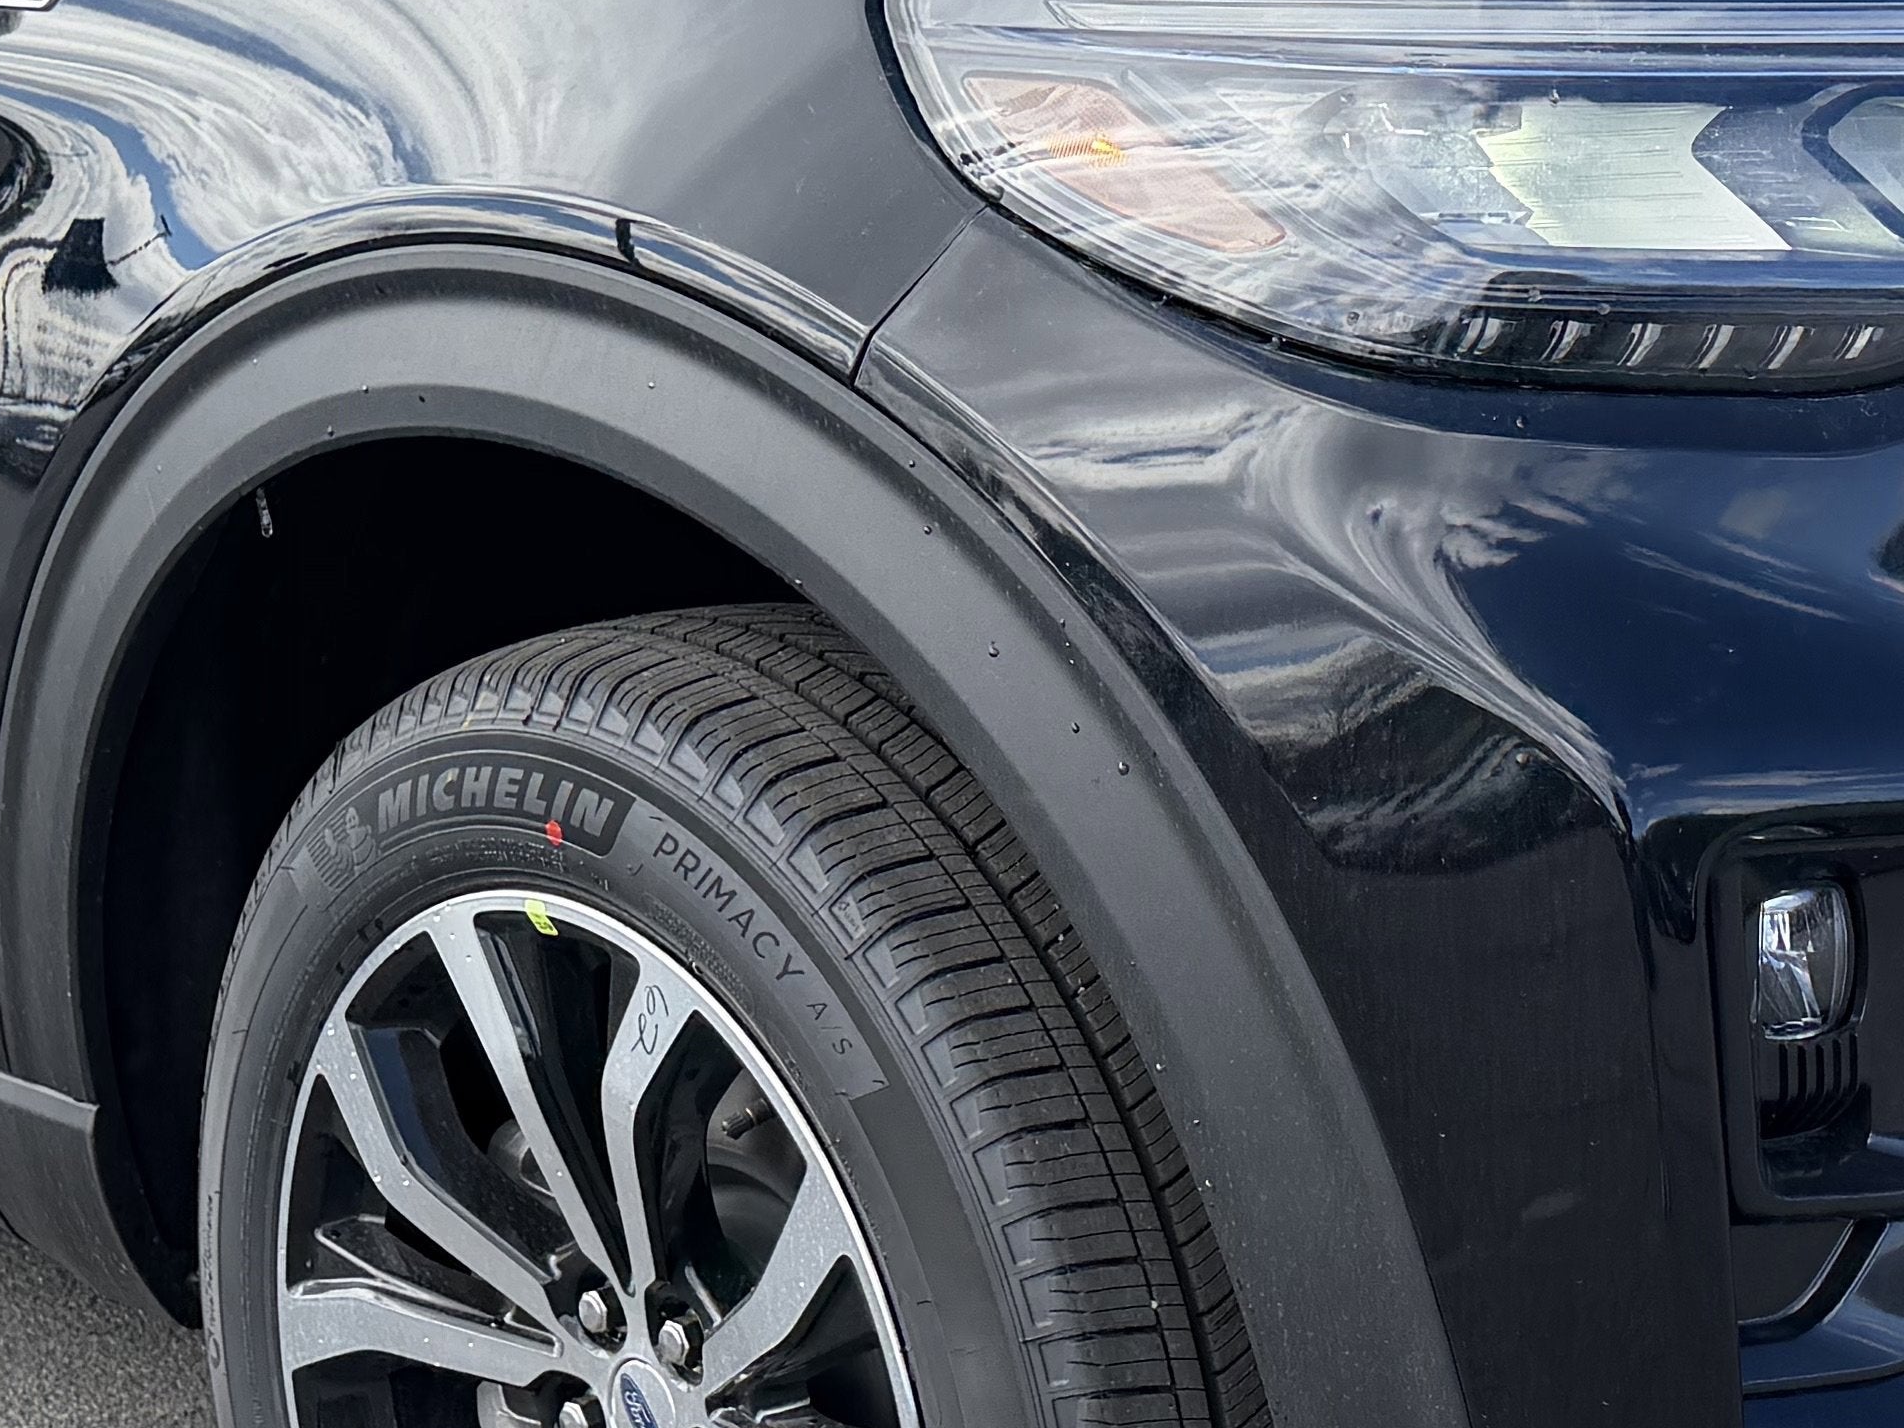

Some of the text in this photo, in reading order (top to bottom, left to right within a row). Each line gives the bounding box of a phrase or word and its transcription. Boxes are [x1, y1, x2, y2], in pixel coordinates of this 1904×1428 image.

[378, 766, 615, 837] MICHELIN
[652, 831, 853, 1055] PRIMACY A/S
